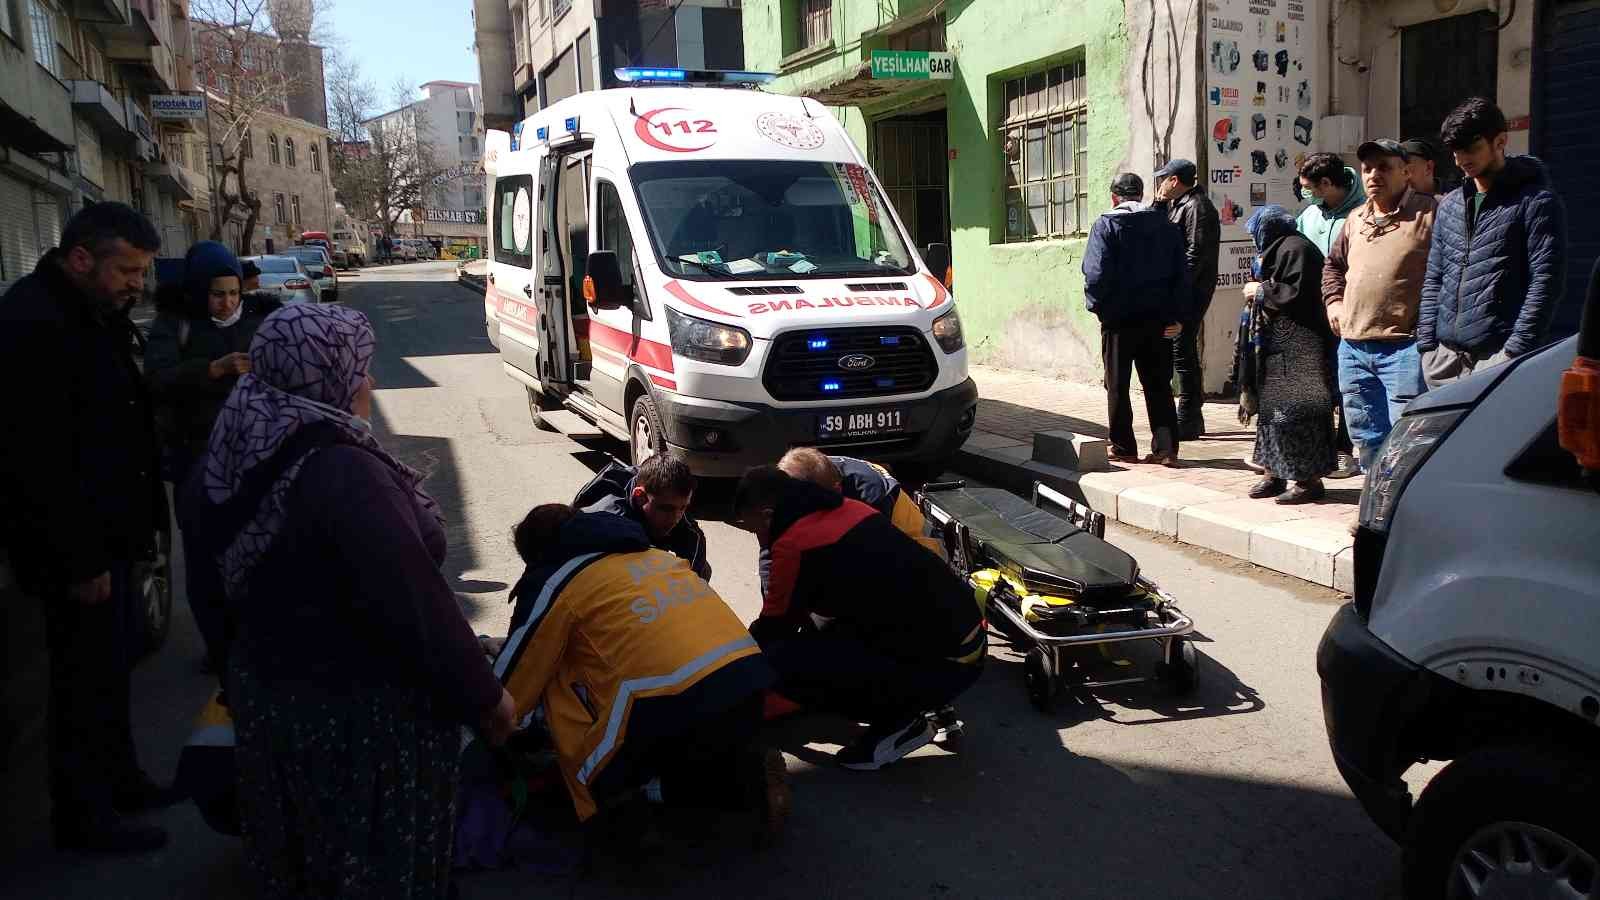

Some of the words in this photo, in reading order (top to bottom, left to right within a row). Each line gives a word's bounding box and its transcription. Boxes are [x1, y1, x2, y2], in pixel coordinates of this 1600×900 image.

[655, 119, 717, 136] 112
[847, 357, 868, 368] Ford
[826, 416, 843, 432] 59
[848, 413, 873, 430] ABH
[877, 411, 900, 427] 911
